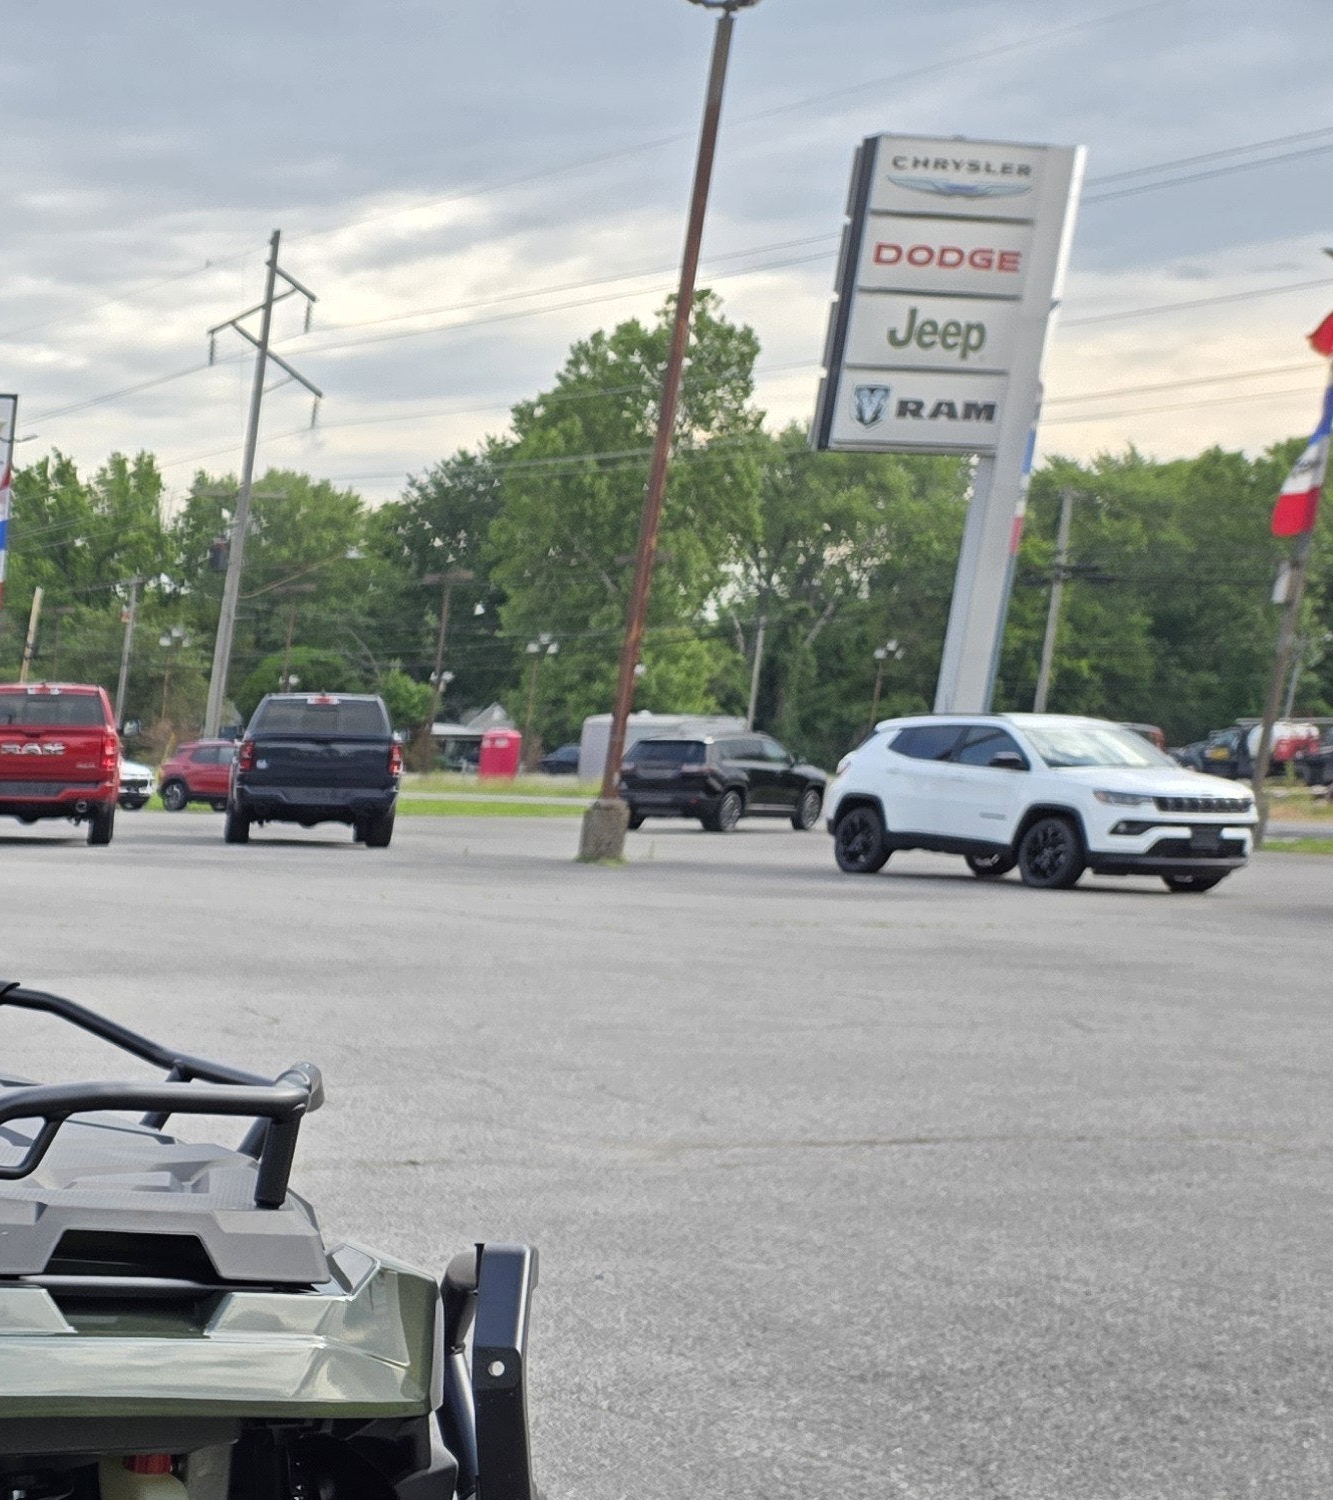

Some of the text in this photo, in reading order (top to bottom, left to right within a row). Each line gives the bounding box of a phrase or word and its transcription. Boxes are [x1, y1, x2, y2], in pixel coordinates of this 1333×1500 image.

[891, 154, 1033, 177] CHRYSLER
[873, 241, 1022, 273] DODGE
[886, 306, 987, 360] Jeep
[894, 396, 996, 422] RAM
